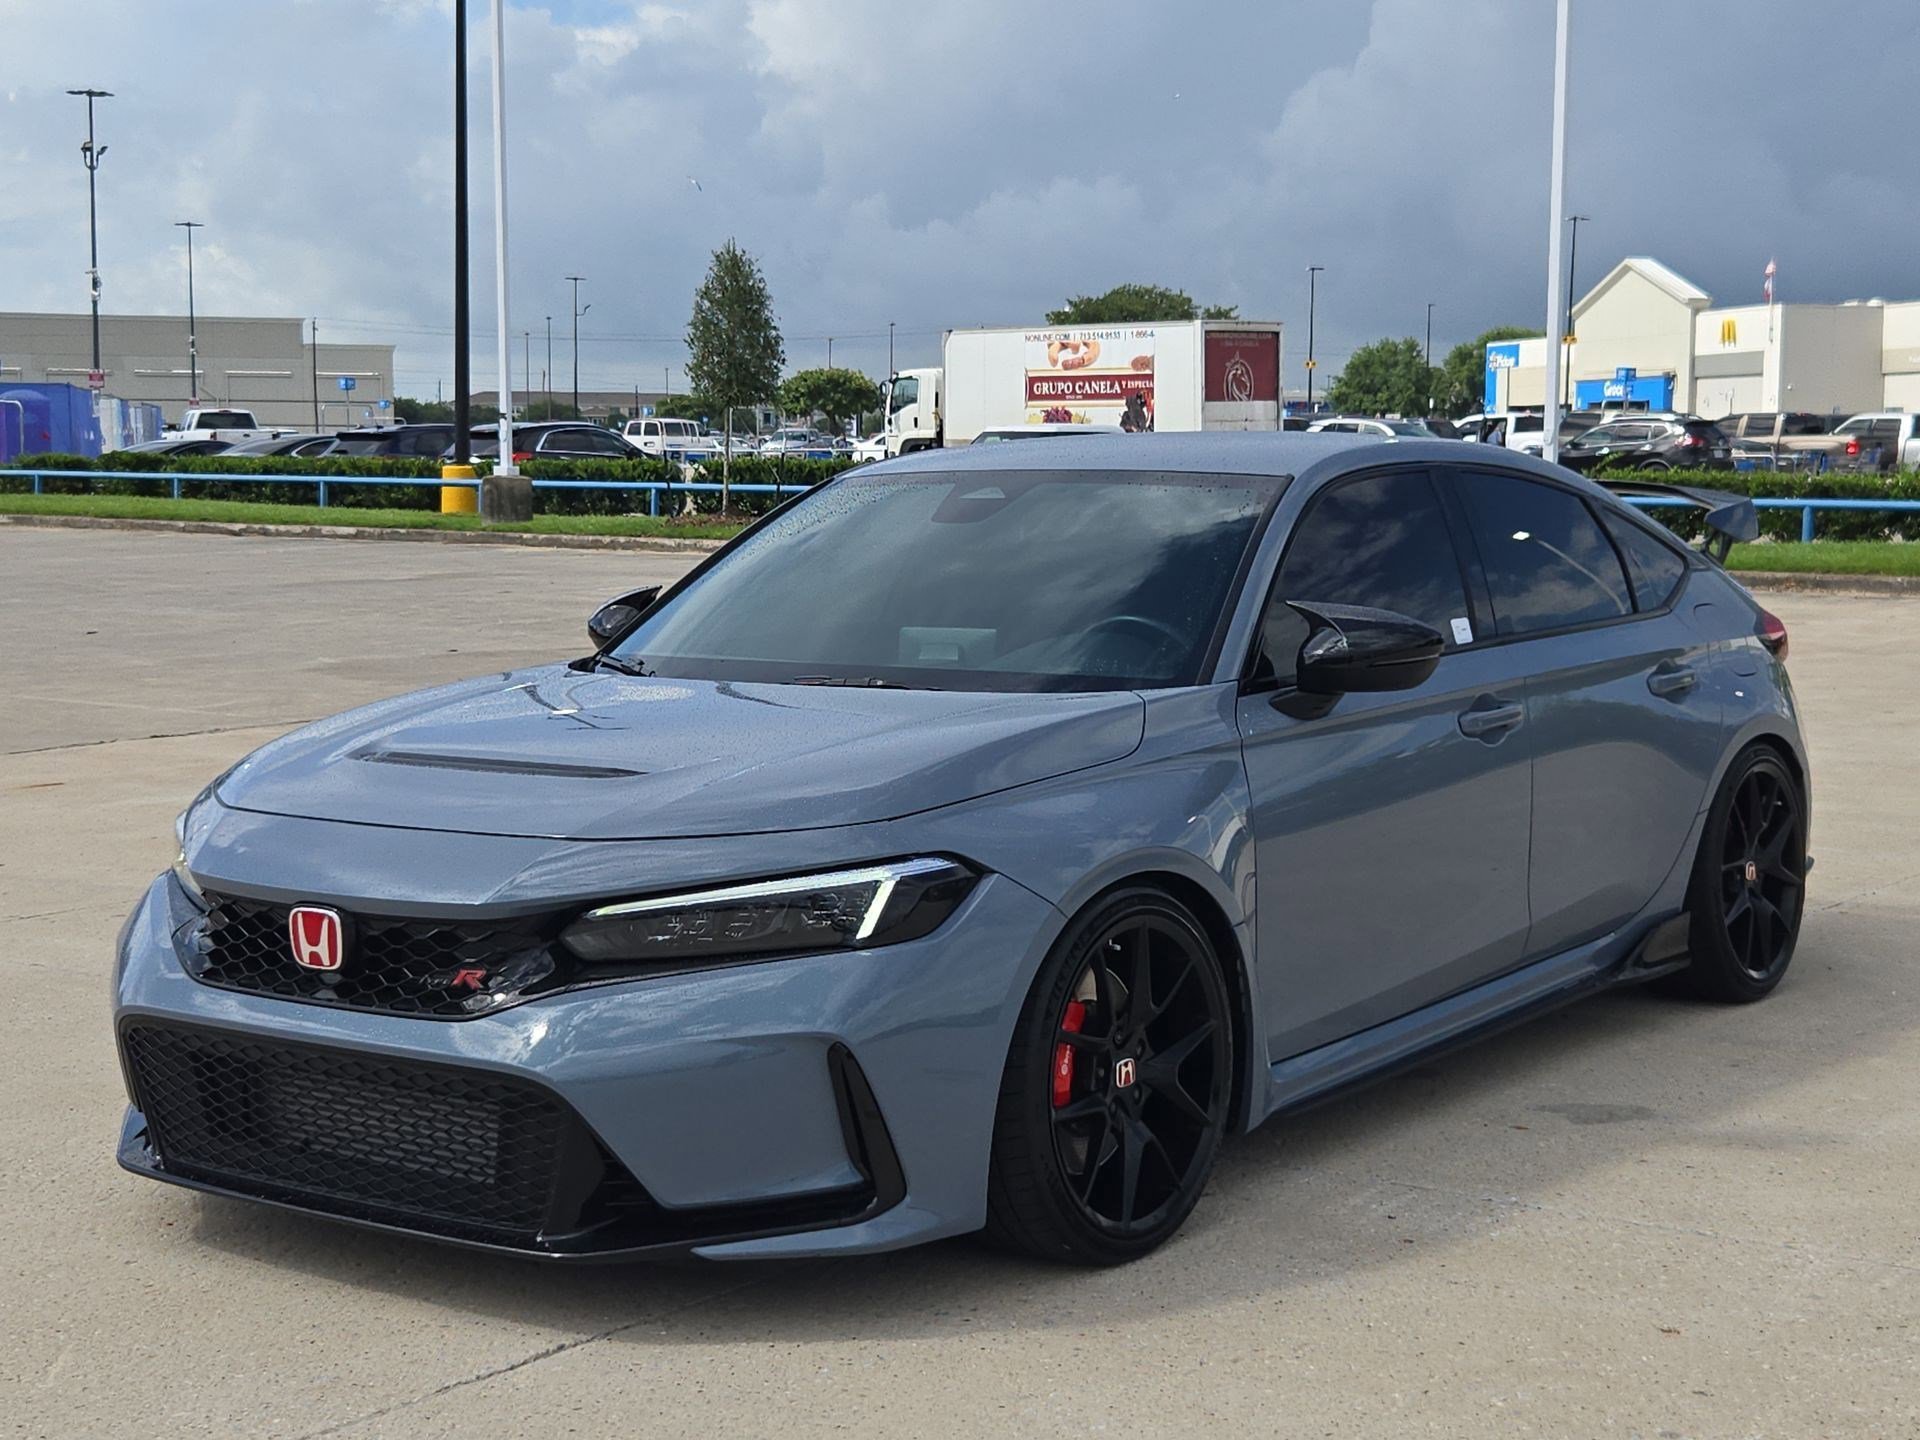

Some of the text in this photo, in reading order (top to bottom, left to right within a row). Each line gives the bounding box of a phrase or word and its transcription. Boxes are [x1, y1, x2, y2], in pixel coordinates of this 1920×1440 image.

[1033, 381, 1073, 395] GRUPO
[1075, 380, 1121, 394] CANELA
[451, 969, 487, 990] R
